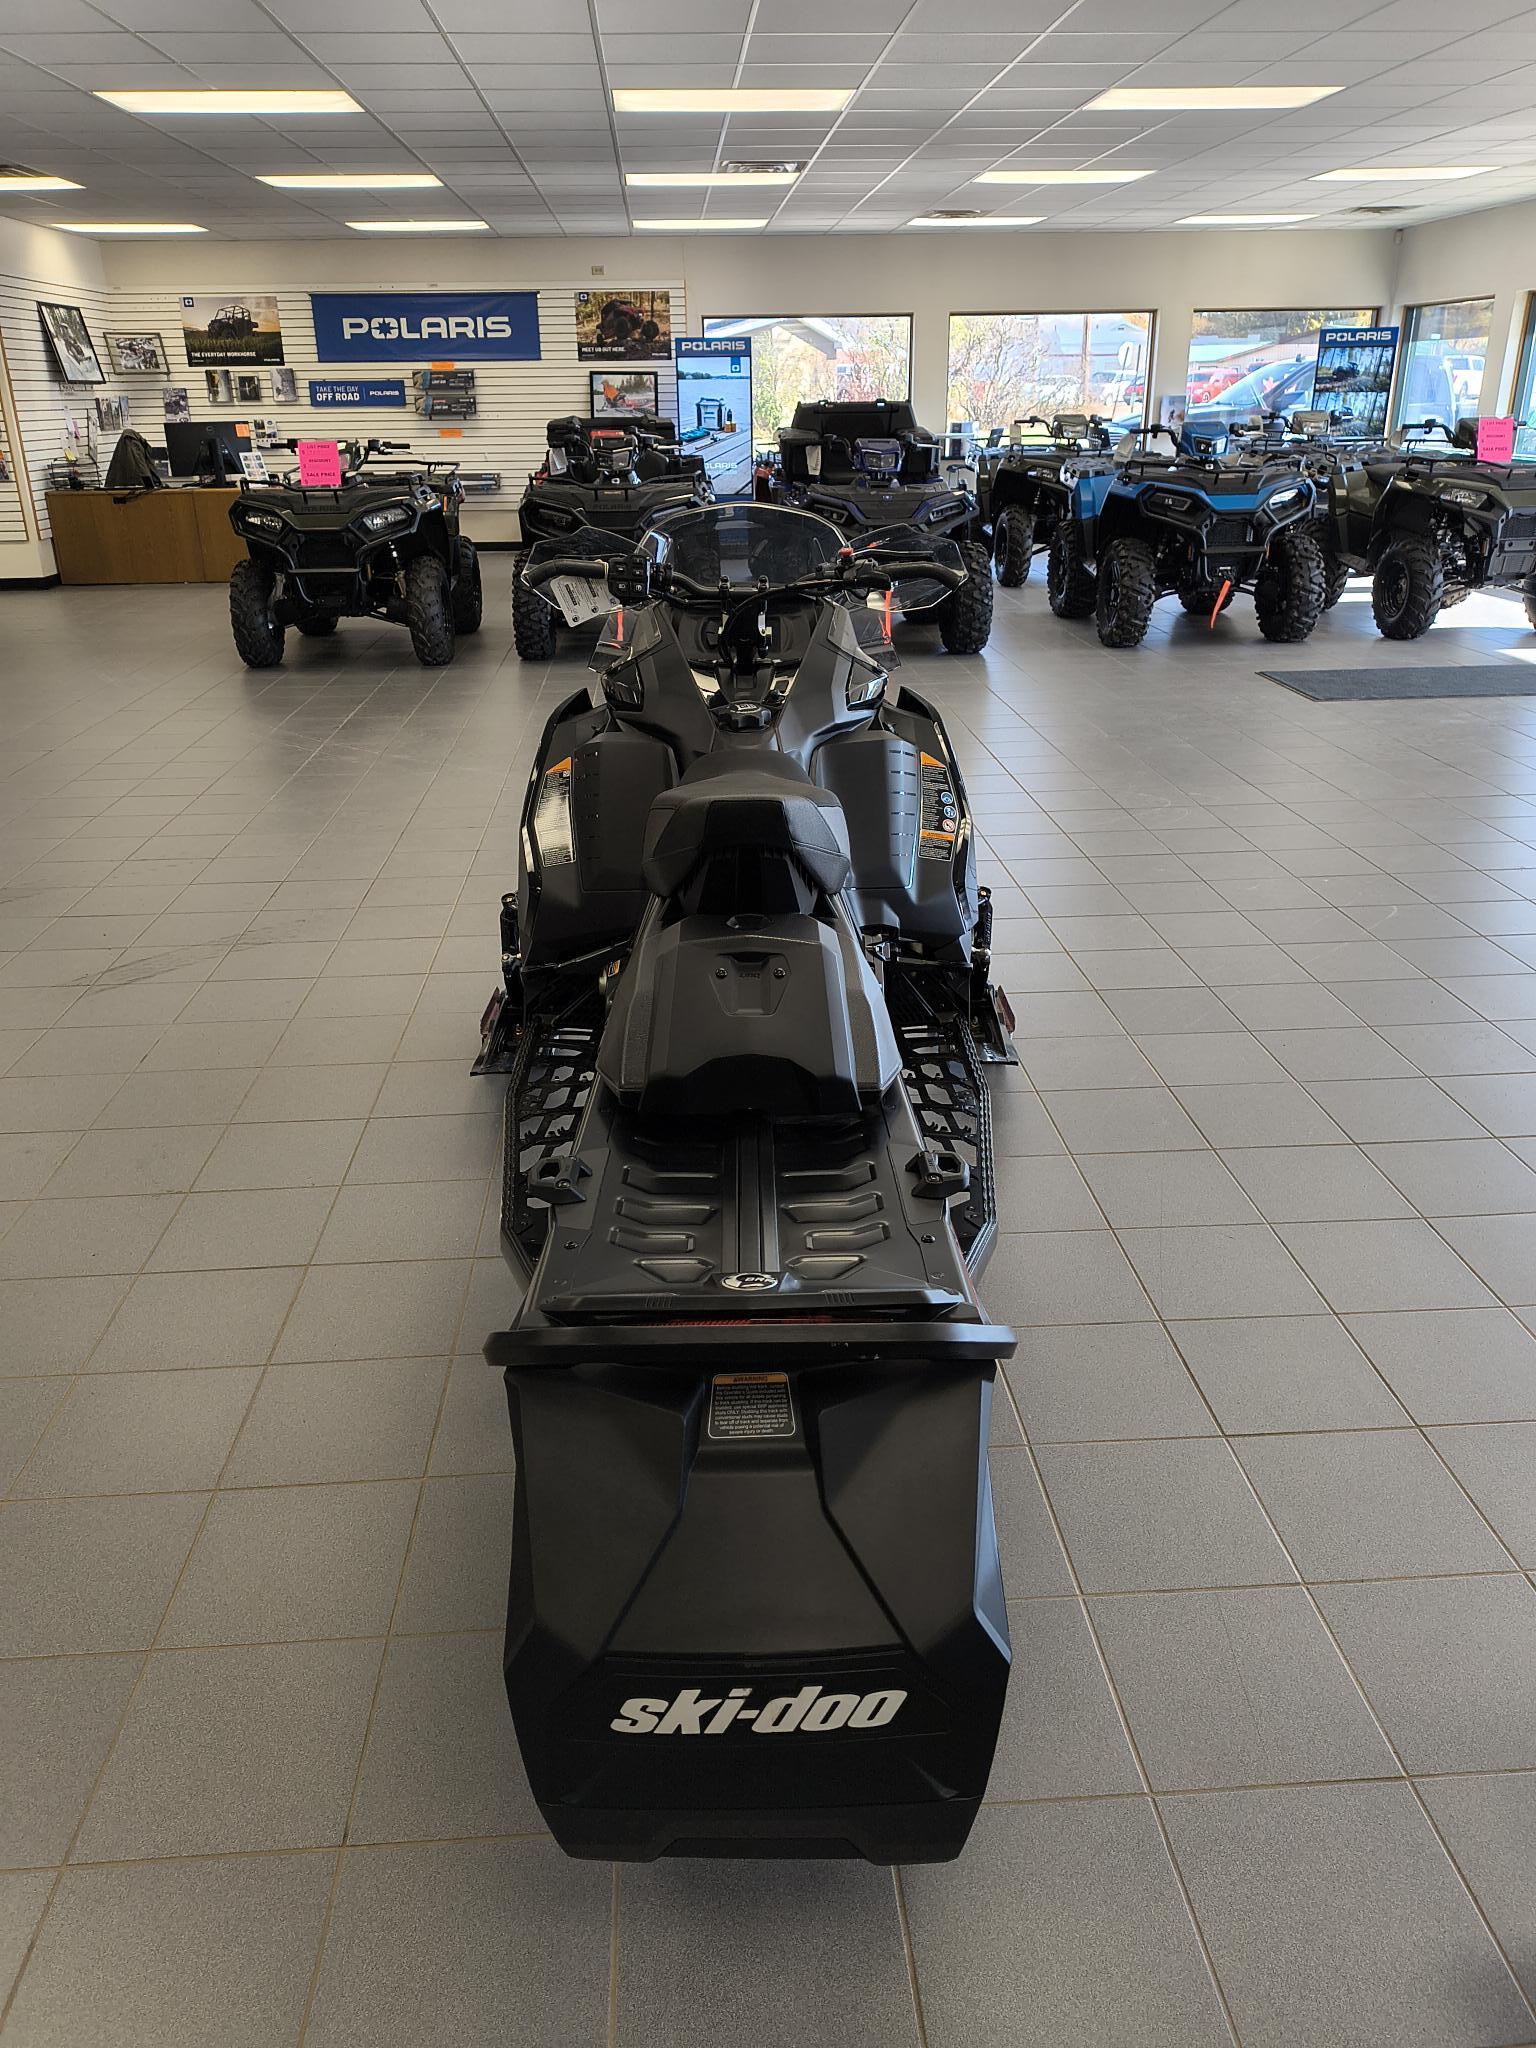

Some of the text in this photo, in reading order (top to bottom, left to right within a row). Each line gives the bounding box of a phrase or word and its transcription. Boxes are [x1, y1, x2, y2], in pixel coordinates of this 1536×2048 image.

[342, 316, 512, 340] POLARIS
[1325, 331, 1391, 341] POLARIS
[682, 341, 746, 351] POLARIS
[316, 393, 360, 401] OFF ROAD
[610, 1686, 907, 1734] ski-doo
